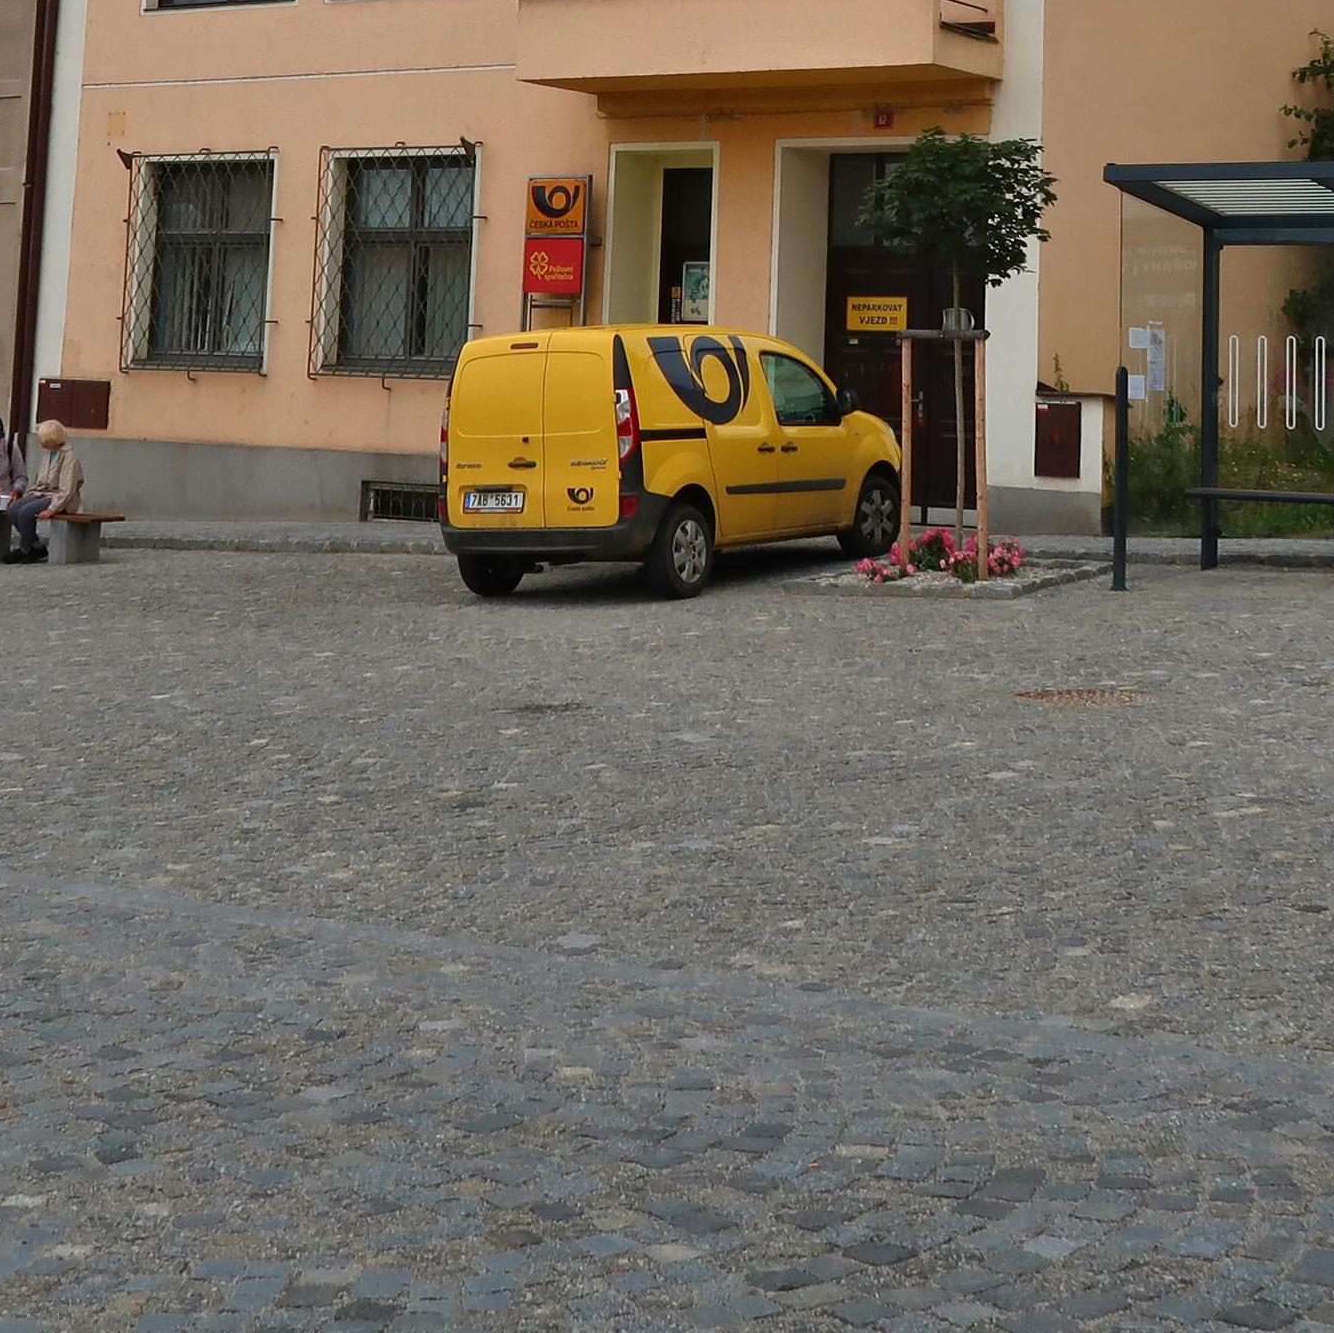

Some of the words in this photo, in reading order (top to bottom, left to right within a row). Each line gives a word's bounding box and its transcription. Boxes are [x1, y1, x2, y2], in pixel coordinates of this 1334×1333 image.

[851, 303, 903, 312] NEPARKOVAT
[859, 316, 888, 325] VJEZD
[471, 494, 488, 507] 7AB
